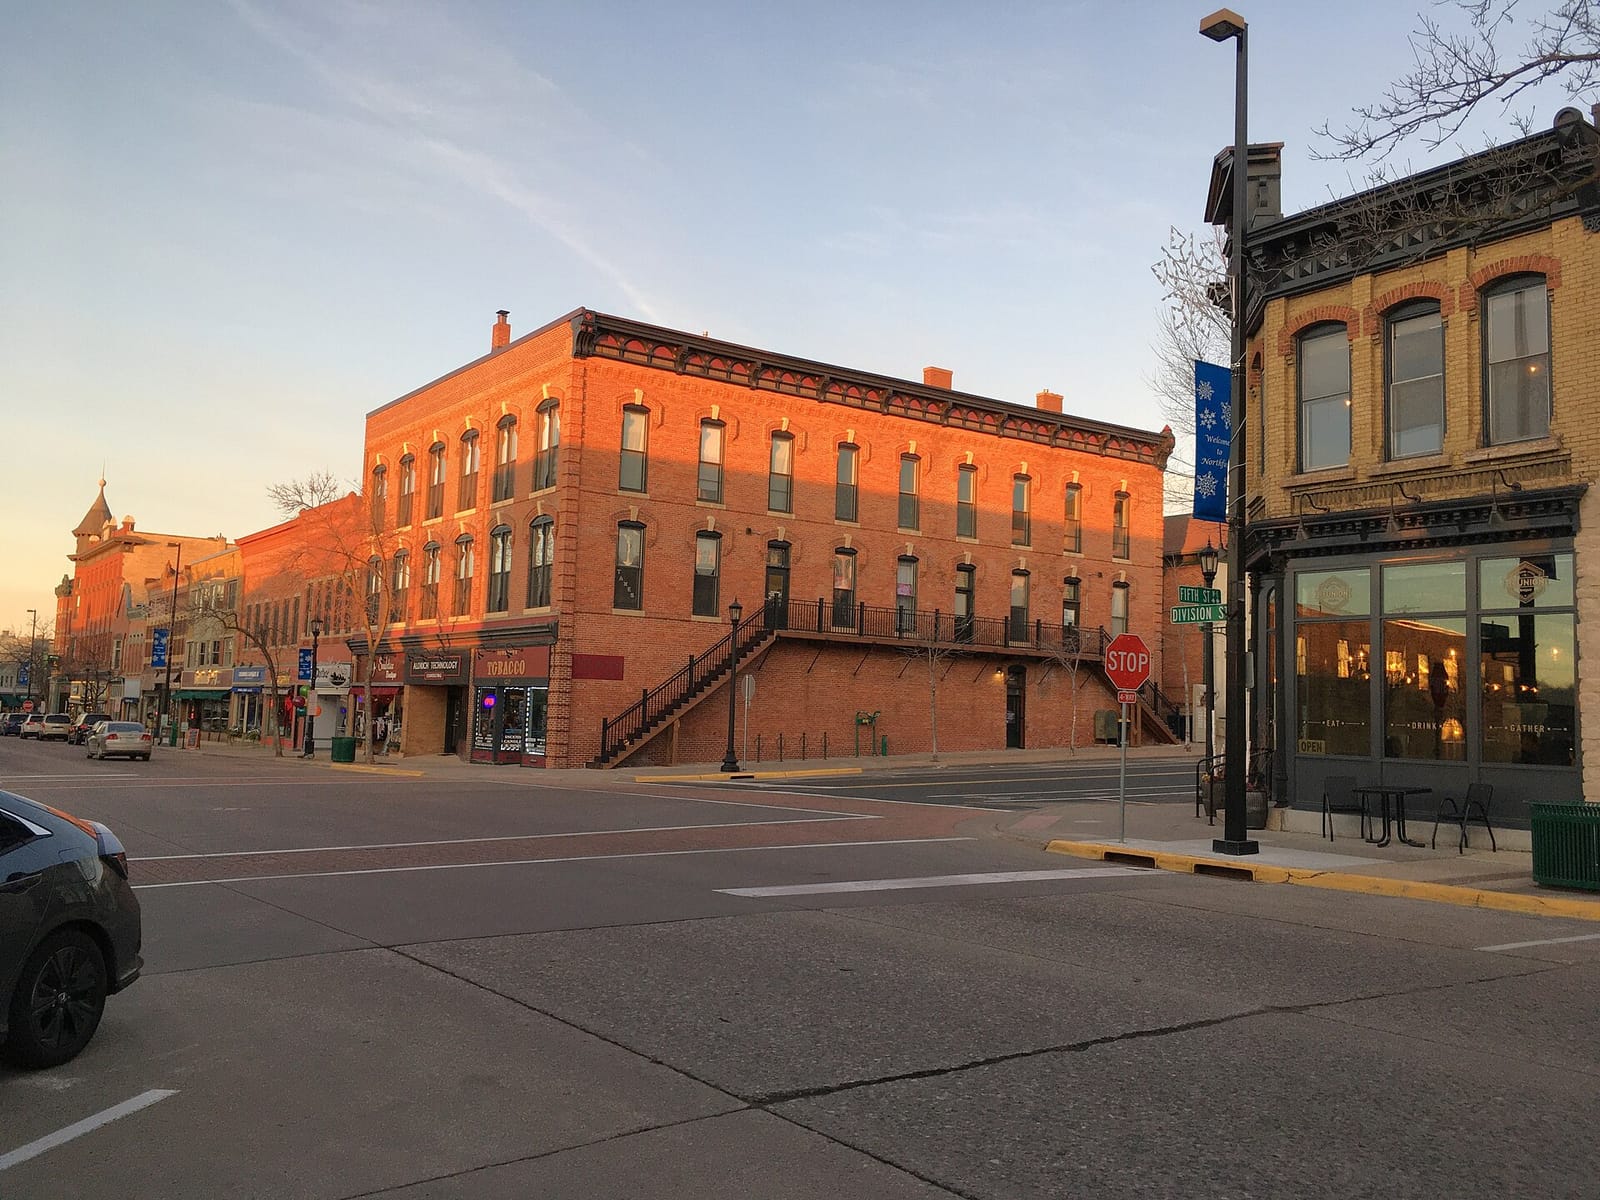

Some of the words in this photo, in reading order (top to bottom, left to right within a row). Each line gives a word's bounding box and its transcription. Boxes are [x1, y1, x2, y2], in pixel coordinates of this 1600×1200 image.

[617, 569, 635, 598] TAXES
[1180, 587, 1199, 602] FIFTH
[1202, 590, 1210, 603] ST
[1172, 607, 1212, 622] DIVISION
[487, 660, 525, 675] TOBACCO
[1108, 650, 1149, 673] STOP
[1412, 721, 1437, 730] DRINK
[1510, 724, 1545, 733] GATHER
[1300, 741, 1323, 753] OPEN
